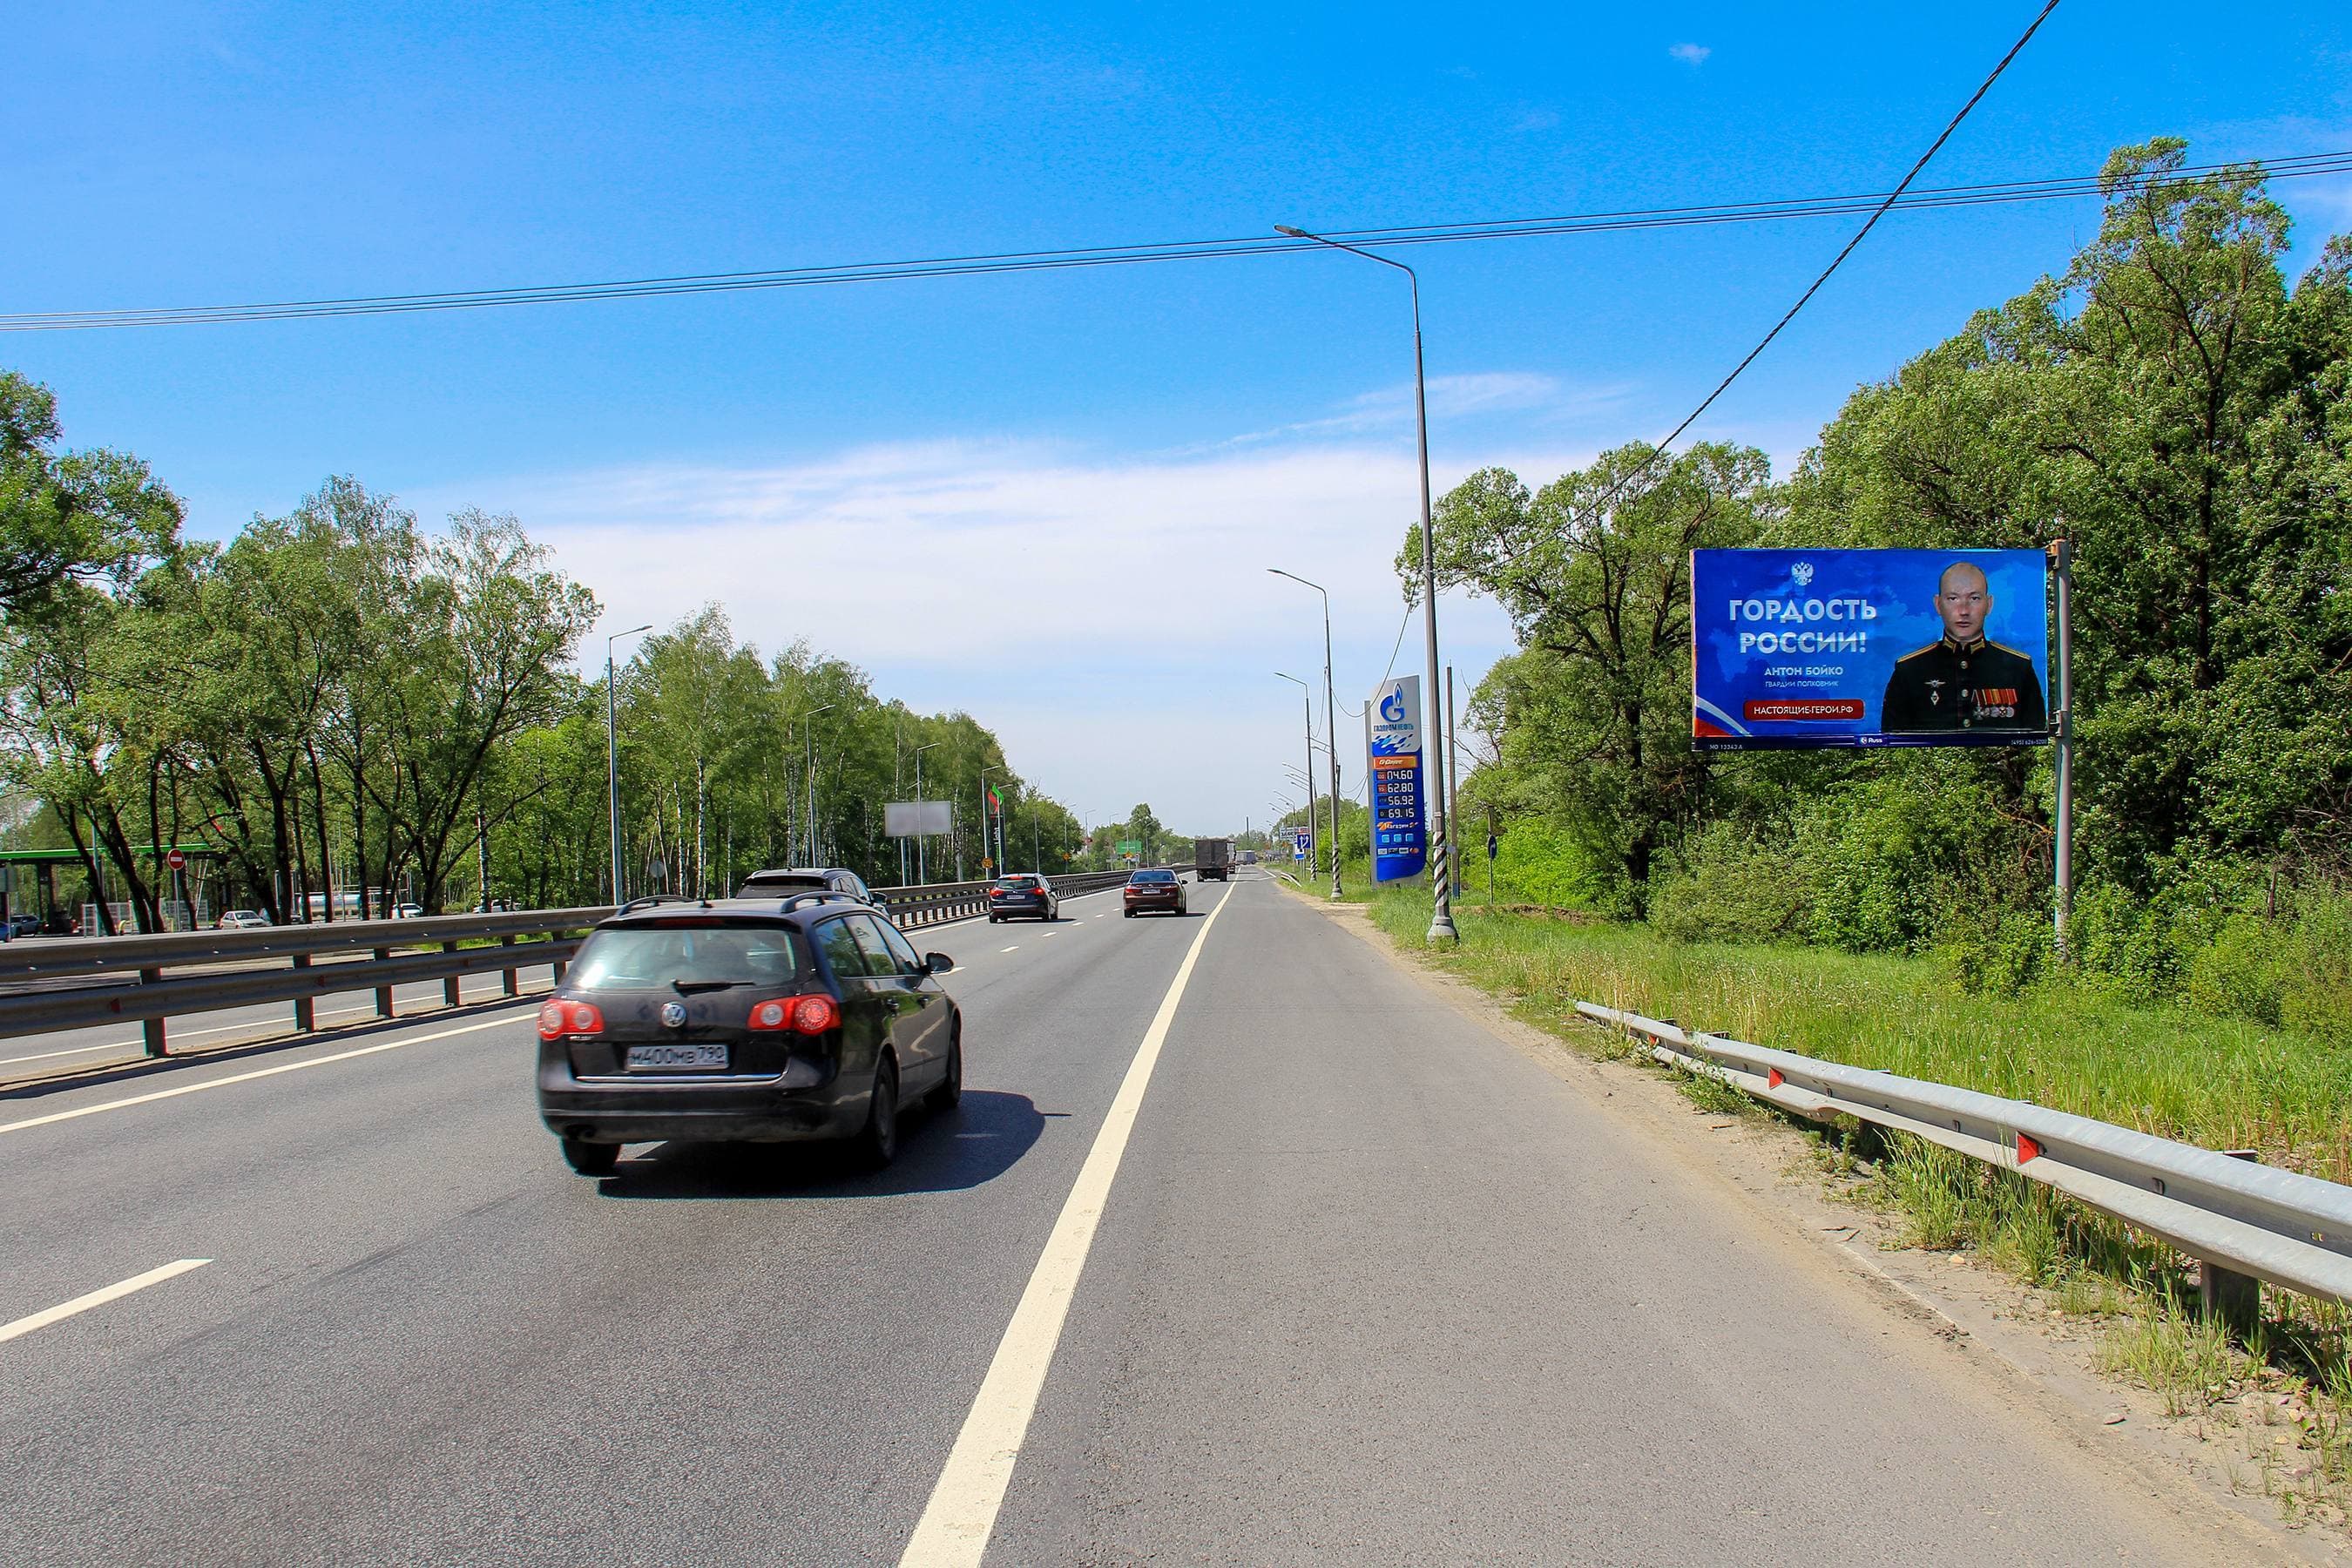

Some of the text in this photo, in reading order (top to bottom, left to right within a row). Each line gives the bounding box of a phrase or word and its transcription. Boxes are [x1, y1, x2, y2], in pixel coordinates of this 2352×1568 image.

[1729, 599, 1877, 624] ГОРДОСТЬ
[1740, 632, 1866, 654] РОССИИ!
[1764, 665, 1844, 676] АНТОН БОЙКО
[1754, 706, 1854, 715] НАСТОЯЩИЕ-ГЕРОИ.РФ
[1387, 782, 1414, 793] 62.80
[1388, 795, 1414, 805] 56.92
